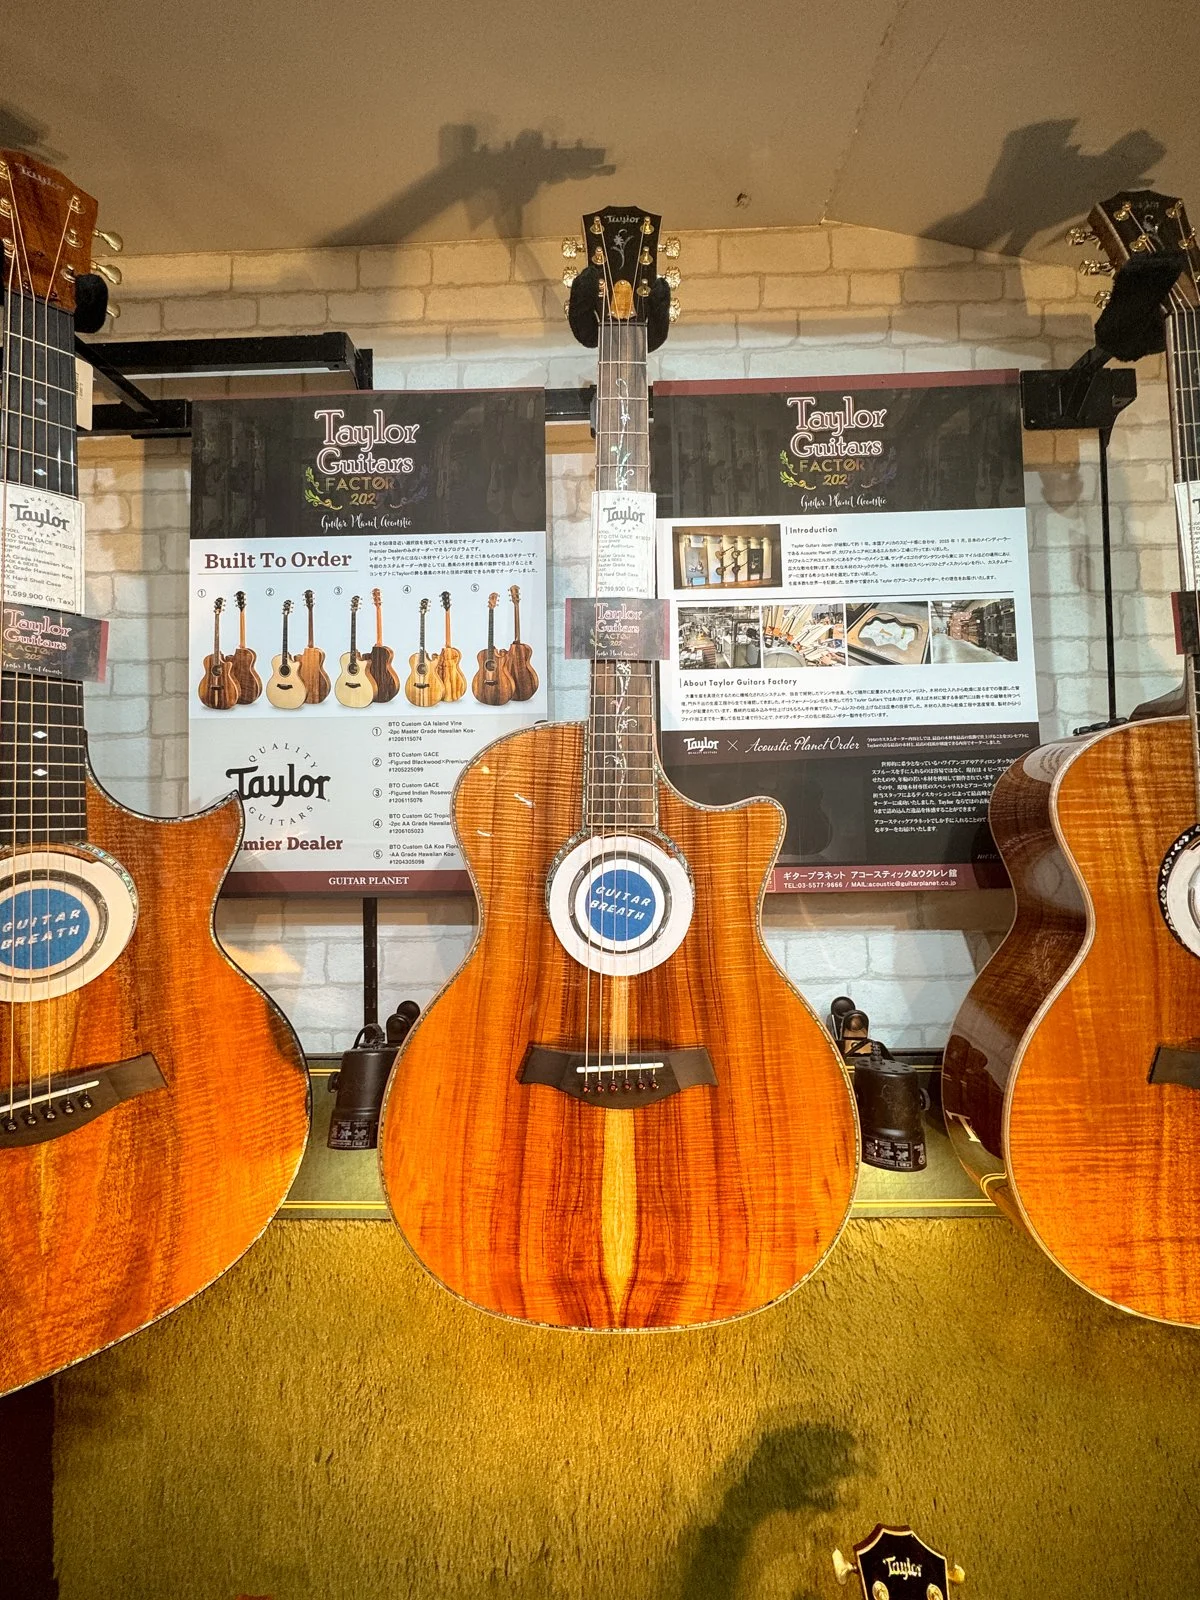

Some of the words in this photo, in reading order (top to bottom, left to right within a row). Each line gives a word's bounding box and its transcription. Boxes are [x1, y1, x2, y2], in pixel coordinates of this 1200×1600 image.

[604, 215, 640, 224] Taylor
[786, 396, 888, 436] Taylor
[314, 409, 420, 452] Taylor
[790, 431, 883, 458] Guitars
[316, 446, 414, 475] Guitars
[9, 503, 70, 531] Taylor
[603, 505, 646, 525] Taylor
[790, 526, 838, 534] Introduction
[204, 552, 256, 569] Built
[260, 552, 287, 568] To
[291, 550, 352, 567] Order
[4, 608, 72, 637] Taylor
[594, 603, 643, 623] Taylor
[597, 620, 640, 633] Guitars
[3, 628, 67, 650] Guitars
[709, 679, 734, 688] Taylor
[737, 678, 766, 686] Guitars
[768, 678, 797, 686] Factory
[683, 736, 719, 752] Taylor
[745, 738, 792, 753] Acoustic
[794, 735, 832, 751] Planet
[829, 736, 860, 750] Order
[248, 743, 318, 768] QUALITY
[225, 763, 331, 808] Taylor
[248, 805, 313, 826] GUITARS
[287, 836, 344, 851] Dealer
[328, 877, 366, 886] GUITAR
[368, 876, 409, 885] PLANET
[783, 871, 846, 881] ギタープラネット
[851, 869, 958, 880] アコースティック&ウクレレ館
[595, 886, 652, 906] GUITAR
[2, 909, 81, 933] GUITAR
[590, 900, 645, 921] BREATH
[0, 925, 80, 950] BREATH
[883, 1555, 922, 1580] Taylor
